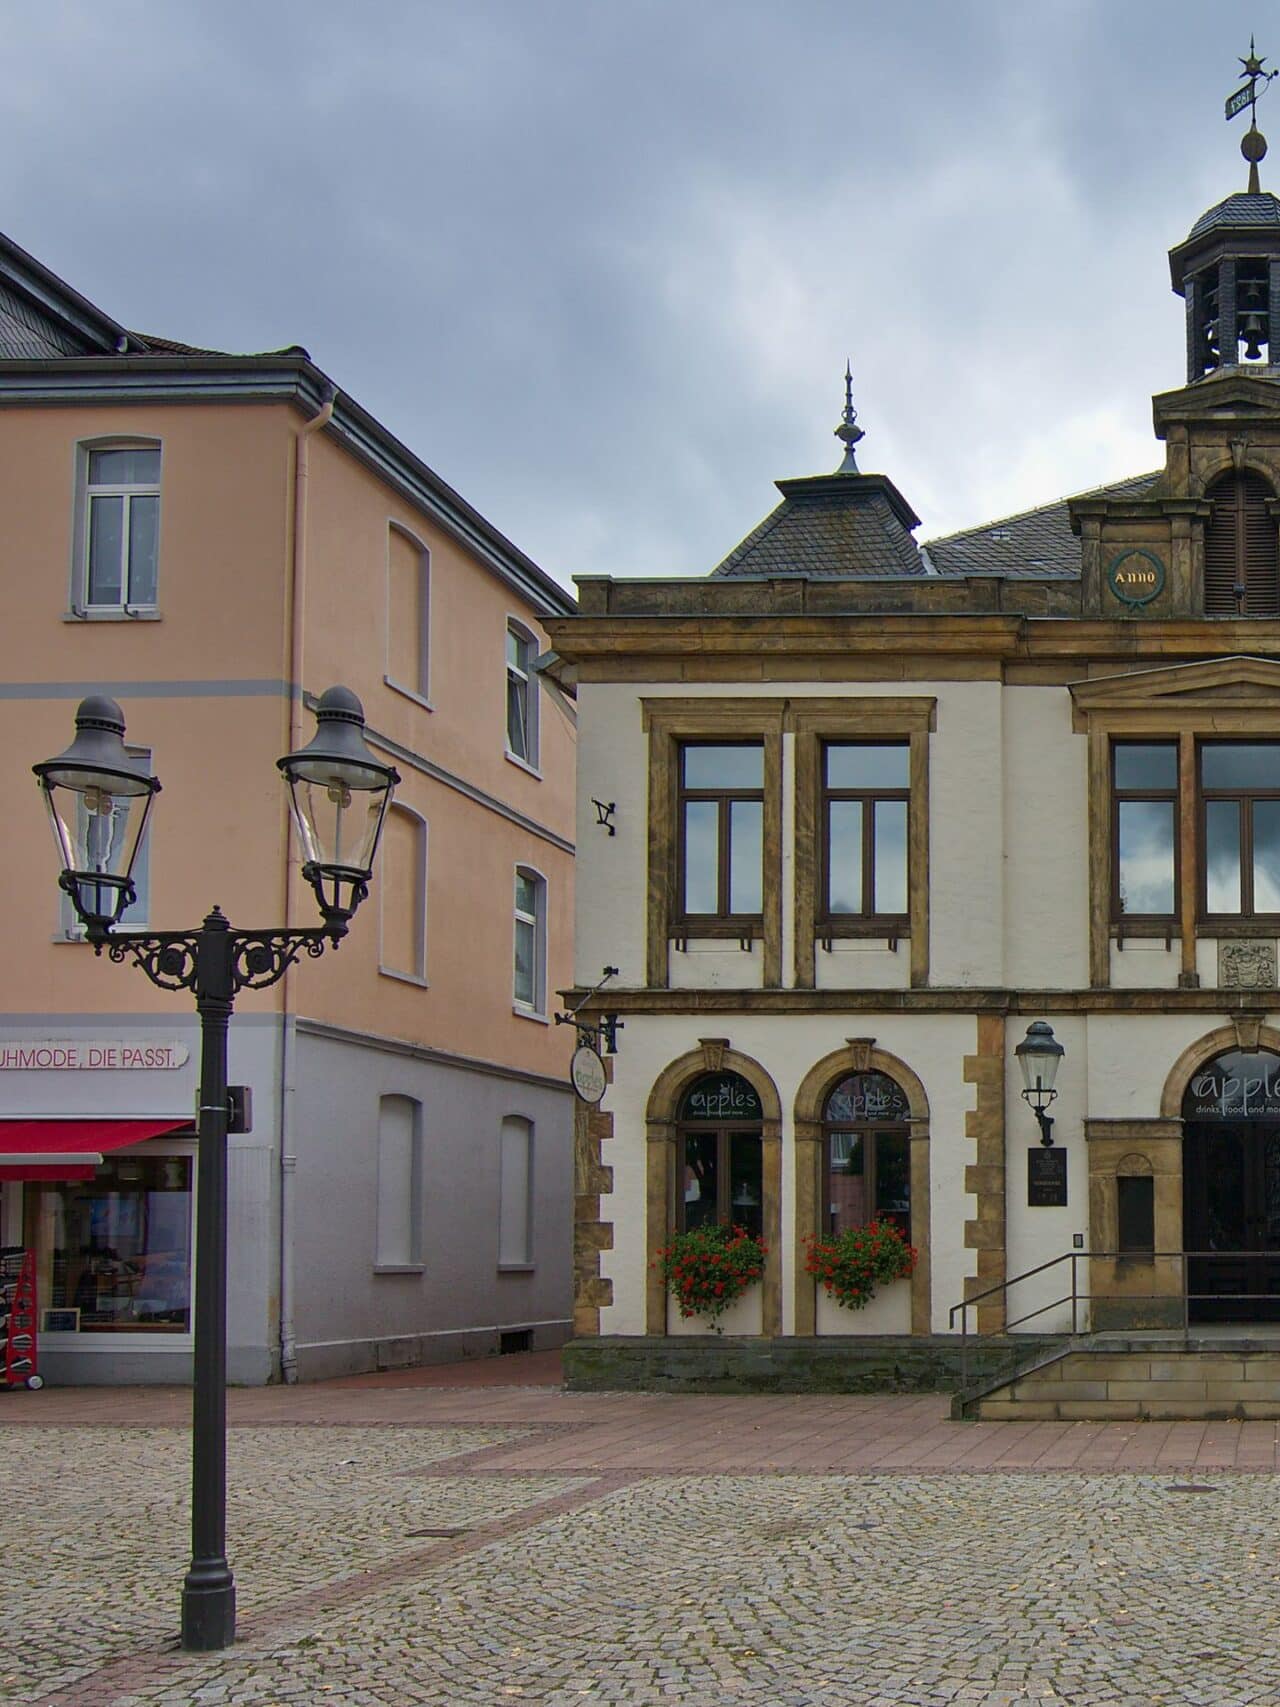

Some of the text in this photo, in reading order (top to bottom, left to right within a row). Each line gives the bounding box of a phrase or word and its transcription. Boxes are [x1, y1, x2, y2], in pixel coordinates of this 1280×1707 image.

[89, 1048, 117, 1067] DIE
[122, 1048, 175, 1067] PASST.
[692, 1087, 757, 1117] apples
[1248, 1104, 1265, 1113] and
